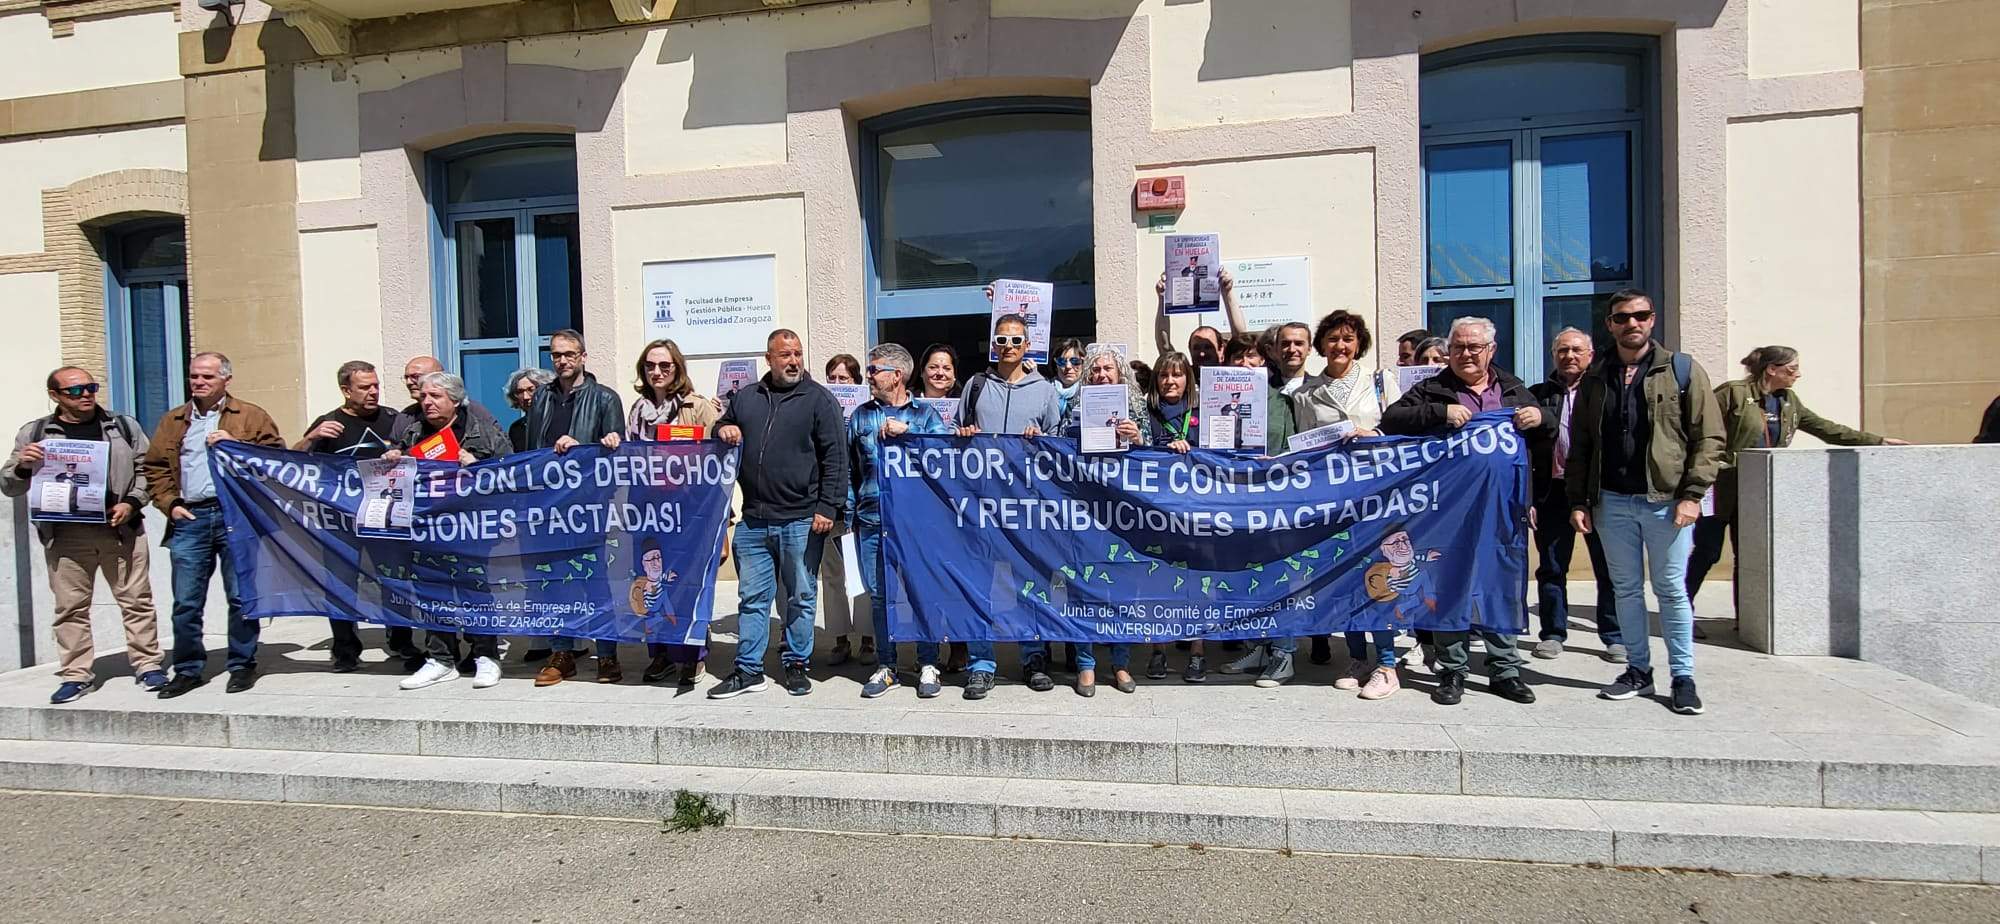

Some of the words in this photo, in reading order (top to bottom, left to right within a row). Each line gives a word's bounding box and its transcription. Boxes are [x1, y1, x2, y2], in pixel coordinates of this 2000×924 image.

[1174, 249, 1183, 257] EN
[1184, 247, 1210, 256] HUELGA
[685, 297, 713, 305] Facultad
[724, 296, 753, 304] Empresa
[1016, 295, 1041, 303] HUELGA
[690, 306, 716, 314] Gestión
[717, 304, 741, 313] Pública
[746, 303, 771, 311] Huesca
[1225, 383, 1254, 392] HUELGA
[61, 454, 93, 463] HUELGA
[884, 445, 1014, 486] RECTOR,
[1025, 450, 1159, 493] ¡CUMPLE
[1169, 461, 1236, 494] CON
[1247, 460, 1311, 493] LOS
[1326, 421, 1518, 486] DERECHOS
[215, 450, 321, 498] RECTOR,
[331, 468, 446, 502] ¡CLE
[455, 466, 516, 497] CON
[526, 459, 582, 491] LOS
[594, 453, 738, 486] DERECHOS
[949, 497, 968, 528] Y
[979, 498, 1234, 537] RETRIBUCIONES
[1247, 480, 1440, 534] PACTADAS!
[528, 502, 682, 536] PACTADAS!
[431, 600, 457, 612] PAS
[462, 599, 503, 613] Comité
[506, 600, 520, 612] de
[524, 600, 571, 615] Empresa
[573, 601, 596, 616] PAS
[1060, 603, 1095, 618] Junta
[1098, 603, 1115, 618] de
[1119, 604, 1146, 618] PAS
[1153, 604, 1200, 620] Comité
[1204, 605, 1221, 619] de
[1286, 595, 1316, 611] PAS
[491, 616, 507, 628] DE
[509, 616, 565, 628] ZARAGOZA
[1096, 621, 1183, 636] UNIVERSIDAD
[1206, 616, 1278, 633] ZARAGOZA
